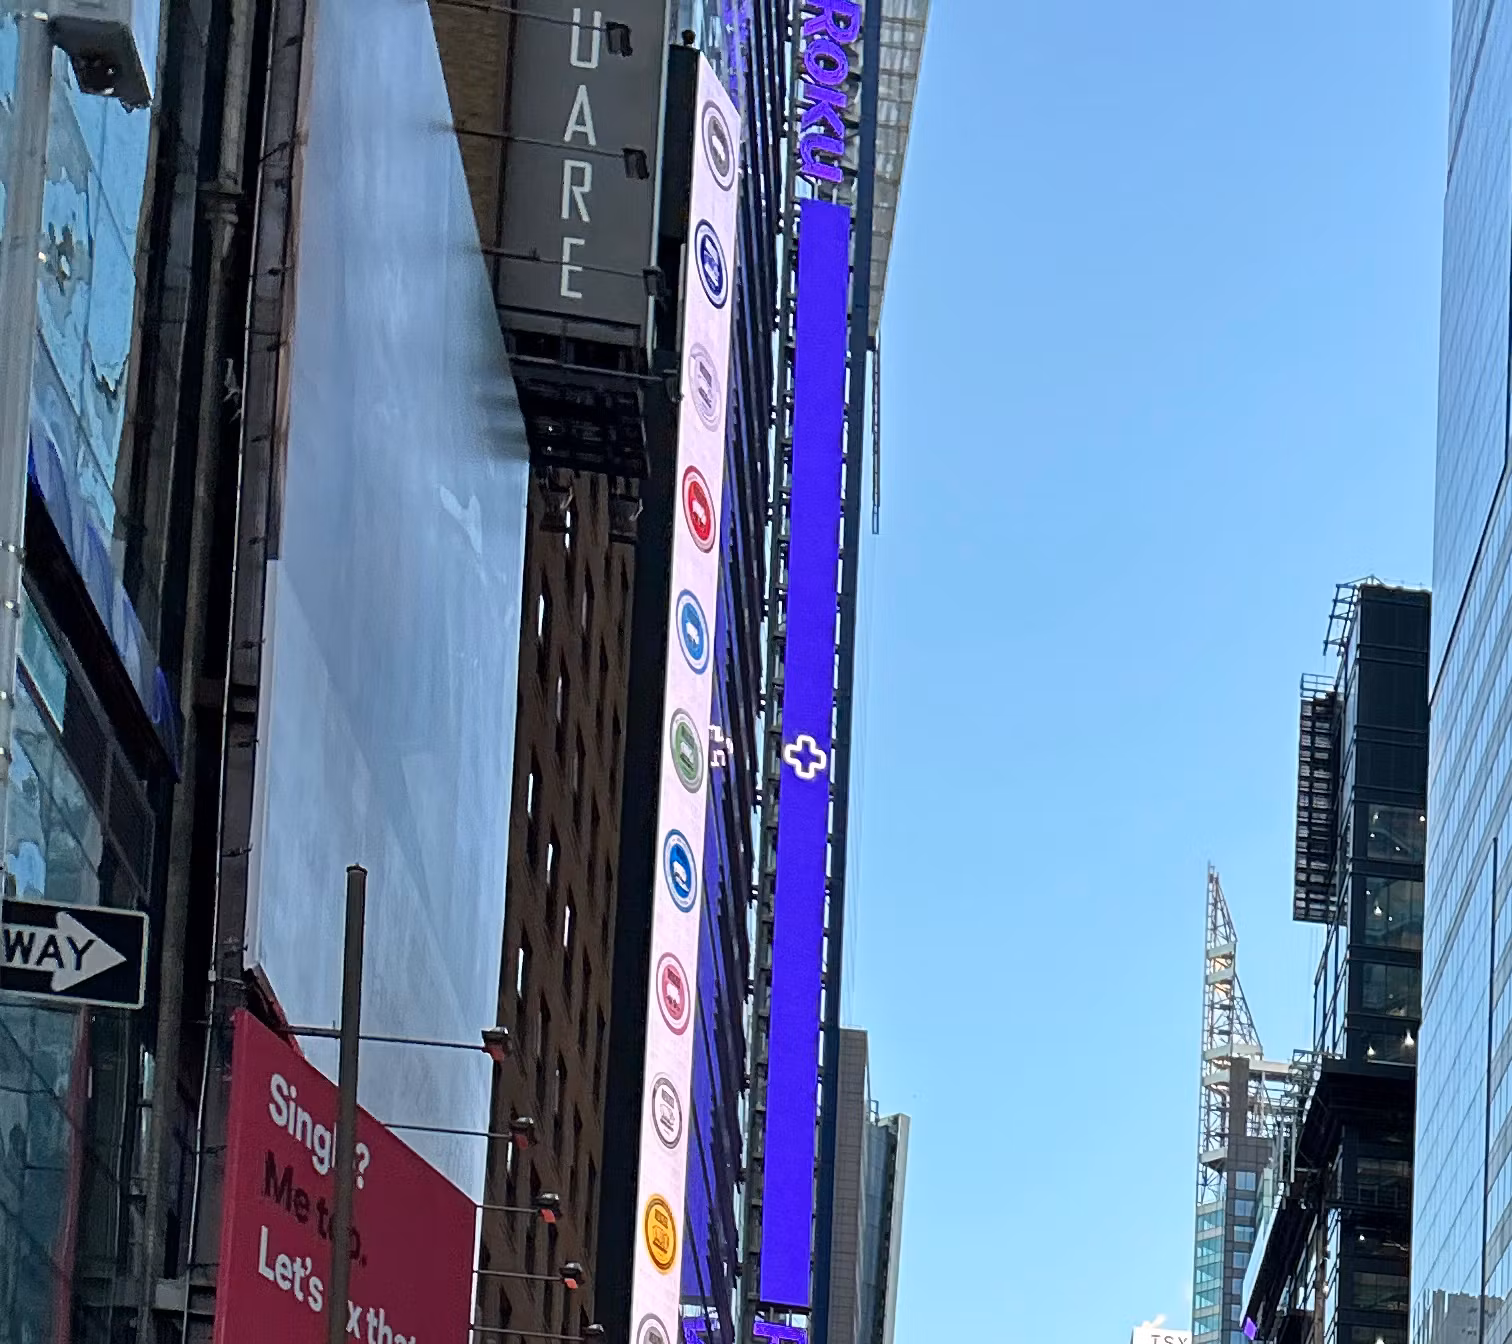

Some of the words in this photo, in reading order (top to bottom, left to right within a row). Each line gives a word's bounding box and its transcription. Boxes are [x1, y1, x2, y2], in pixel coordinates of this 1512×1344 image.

[3, 929, 96, 971] WAY
[269, 1073, 370, 1190] Singl?
[263, 1150, 308, 1225] Me
[316, 1197, 367, 1268] to.
[258, 1225, 324, 1313] Let's
